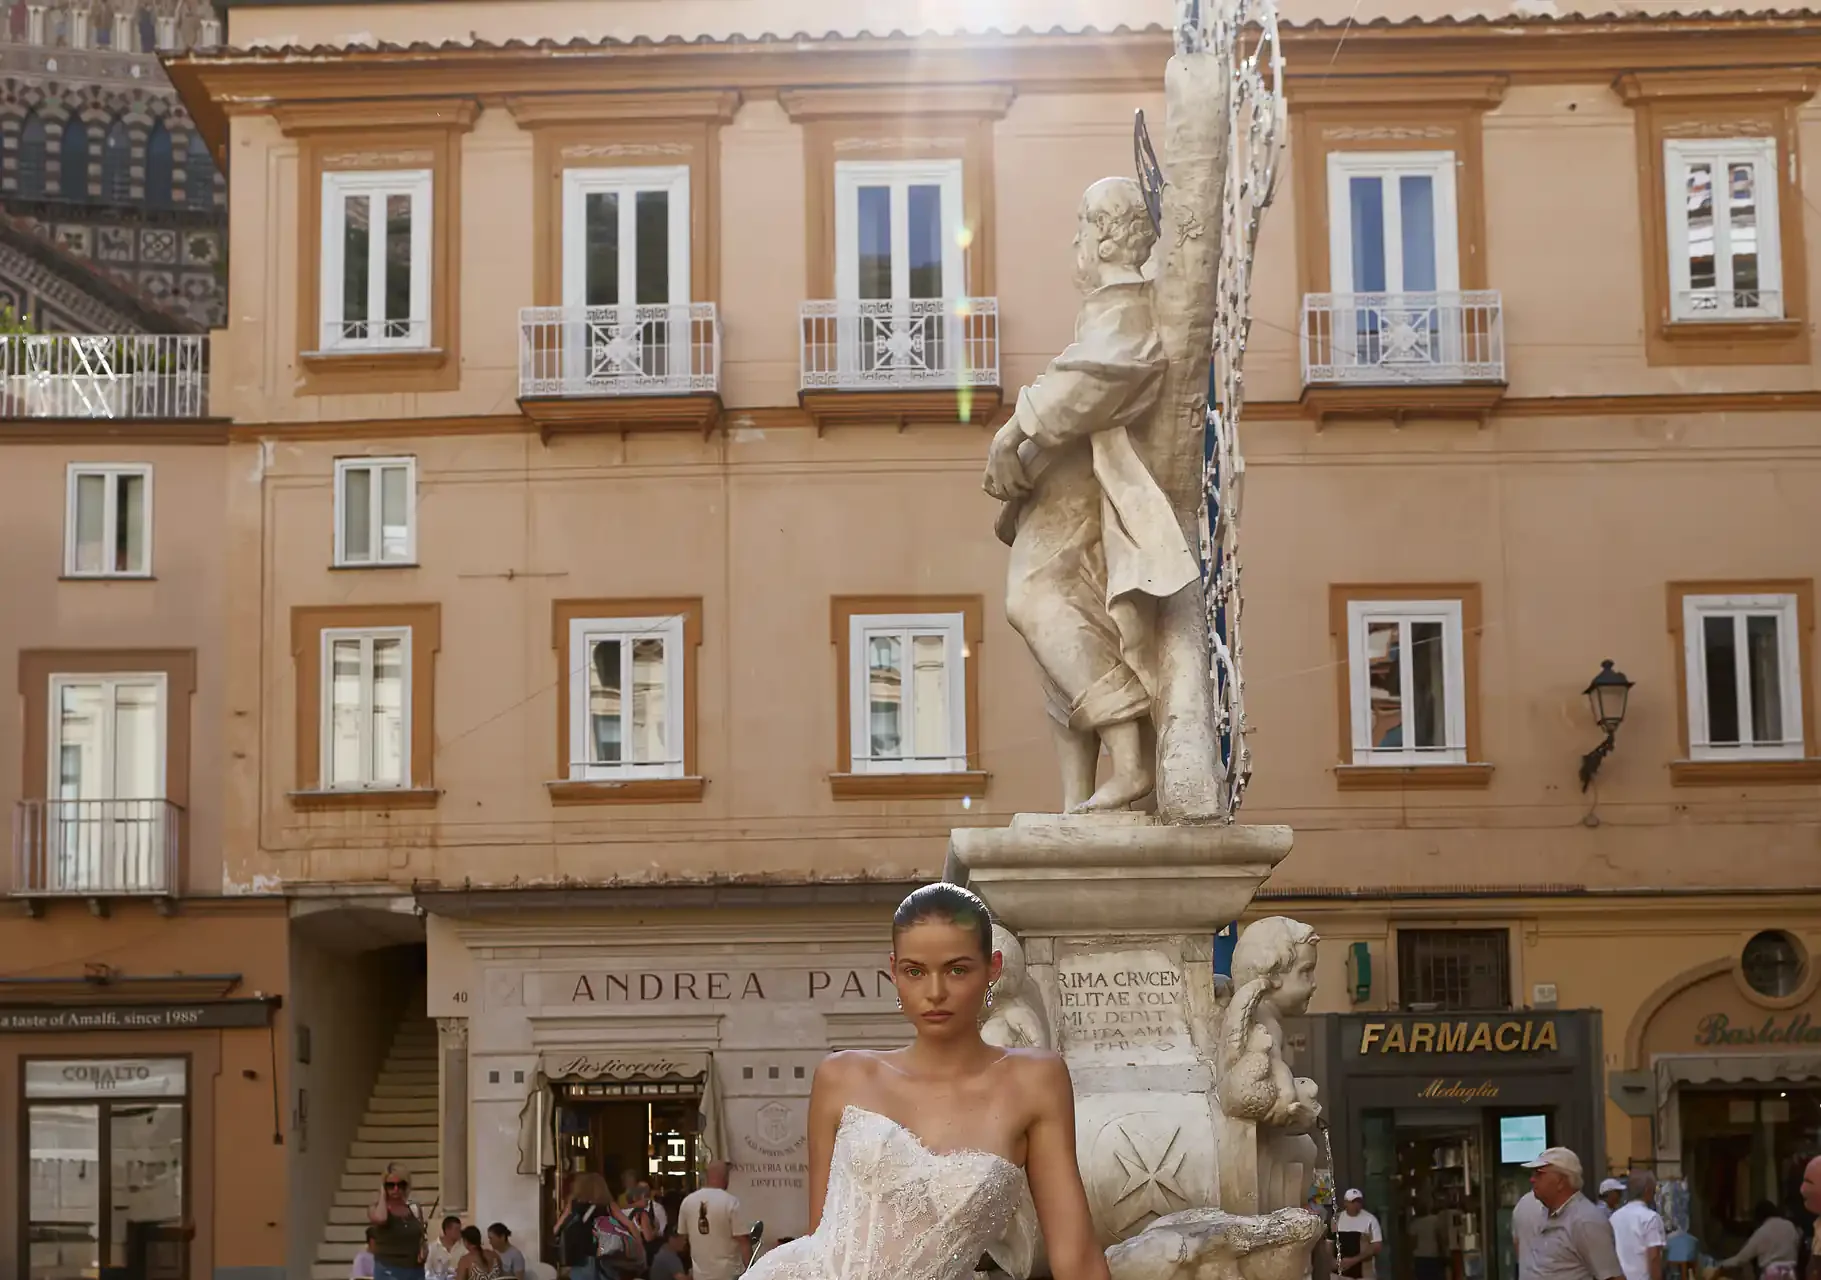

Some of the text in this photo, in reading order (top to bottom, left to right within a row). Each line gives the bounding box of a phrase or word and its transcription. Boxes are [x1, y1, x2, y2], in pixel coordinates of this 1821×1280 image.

[453, 992, 468, 1003] 40
[572, 971, 766, 1001] ANDREA
[12, 1015, 47, 1027] taste
[50, 1012, 65, 1025] of
[68, 1012, 120, 1026] Amalfi,
[124, 1011, 161, 1024] since
[1360, 1021, 1558, 1054] FARMACIA
[1417, 1079, 1500, 1104] Medaglia
